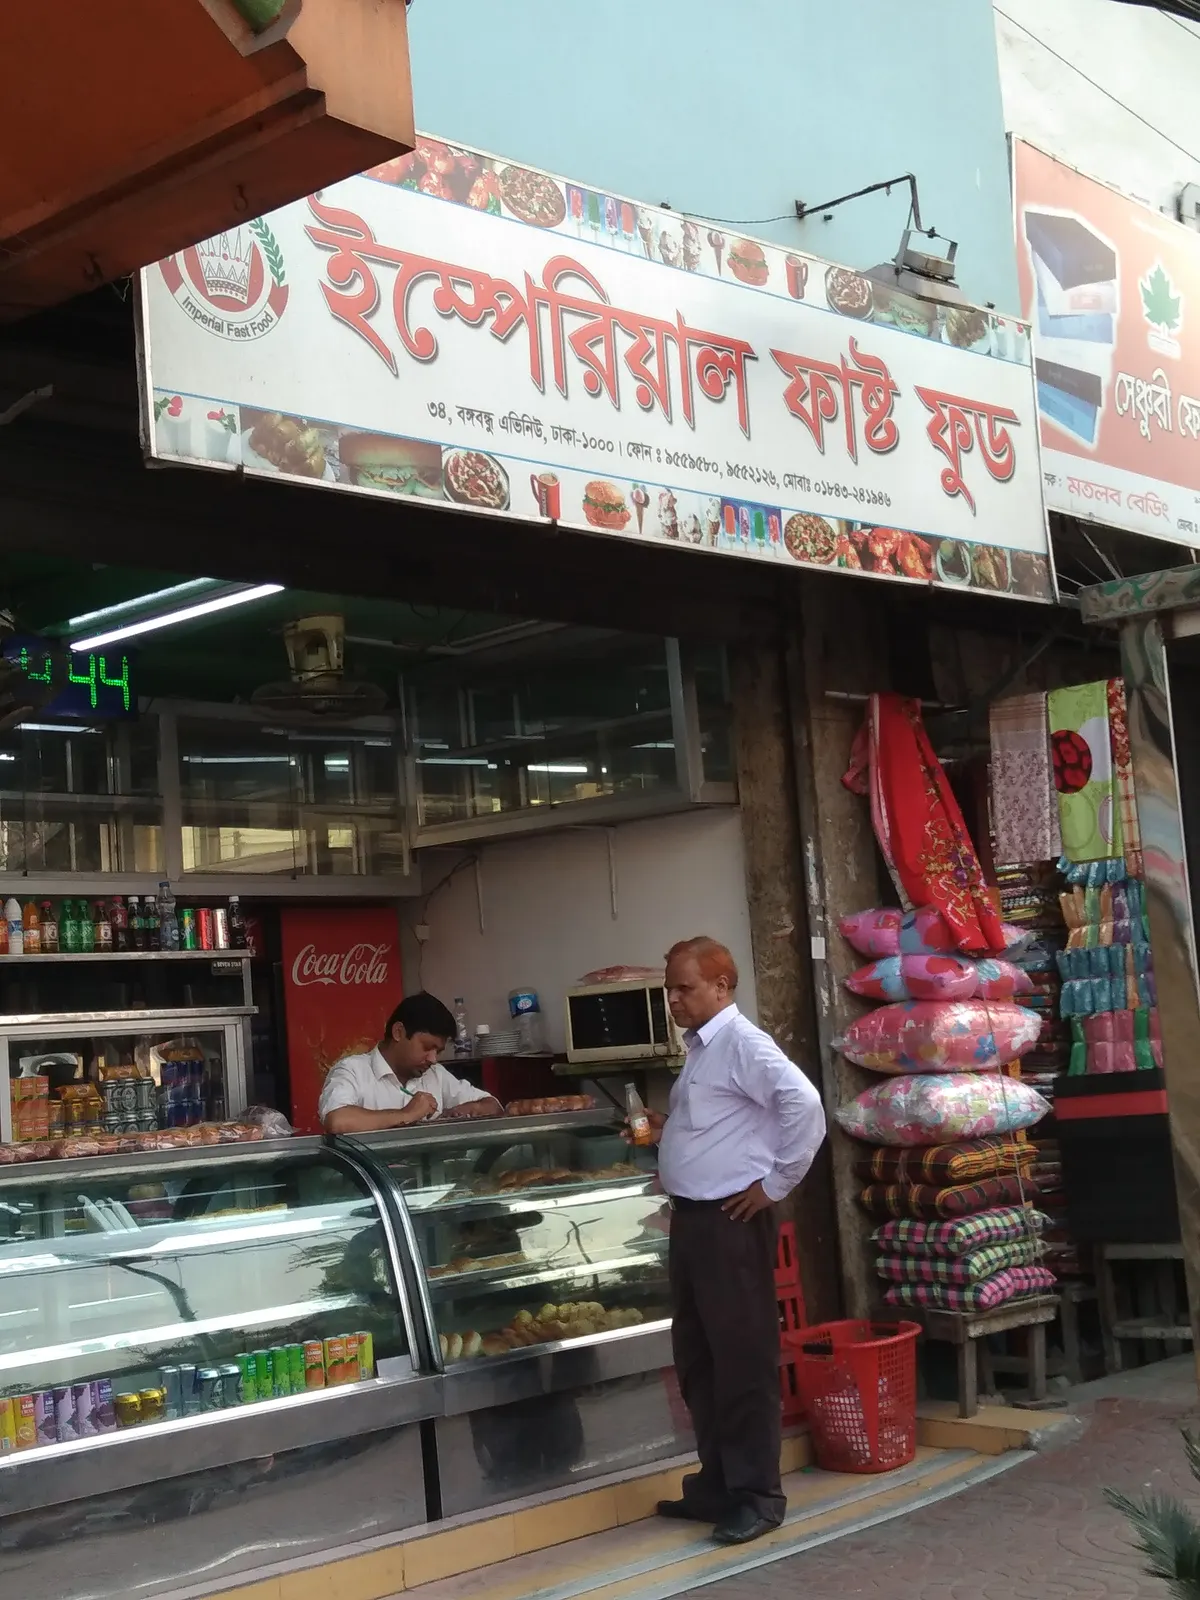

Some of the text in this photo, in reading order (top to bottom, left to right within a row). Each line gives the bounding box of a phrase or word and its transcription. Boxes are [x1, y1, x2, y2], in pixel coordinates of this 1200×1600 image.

[182, 295, 274, 339] Imperial Fast Food
[304, 191, 758, 440] ইম্পেরিয়াল
[913, 385, 1021, 516] ফুড
[427, 401, 453, 425] ৩৪,
[455, 405, 495, 436] বঙ্গবন্ধু
[1066, 475, 1123, 508] মতলব
[1126, 491, 1172, 524] বেডিং
[292, 943, 392, 986] Coca-Cola
